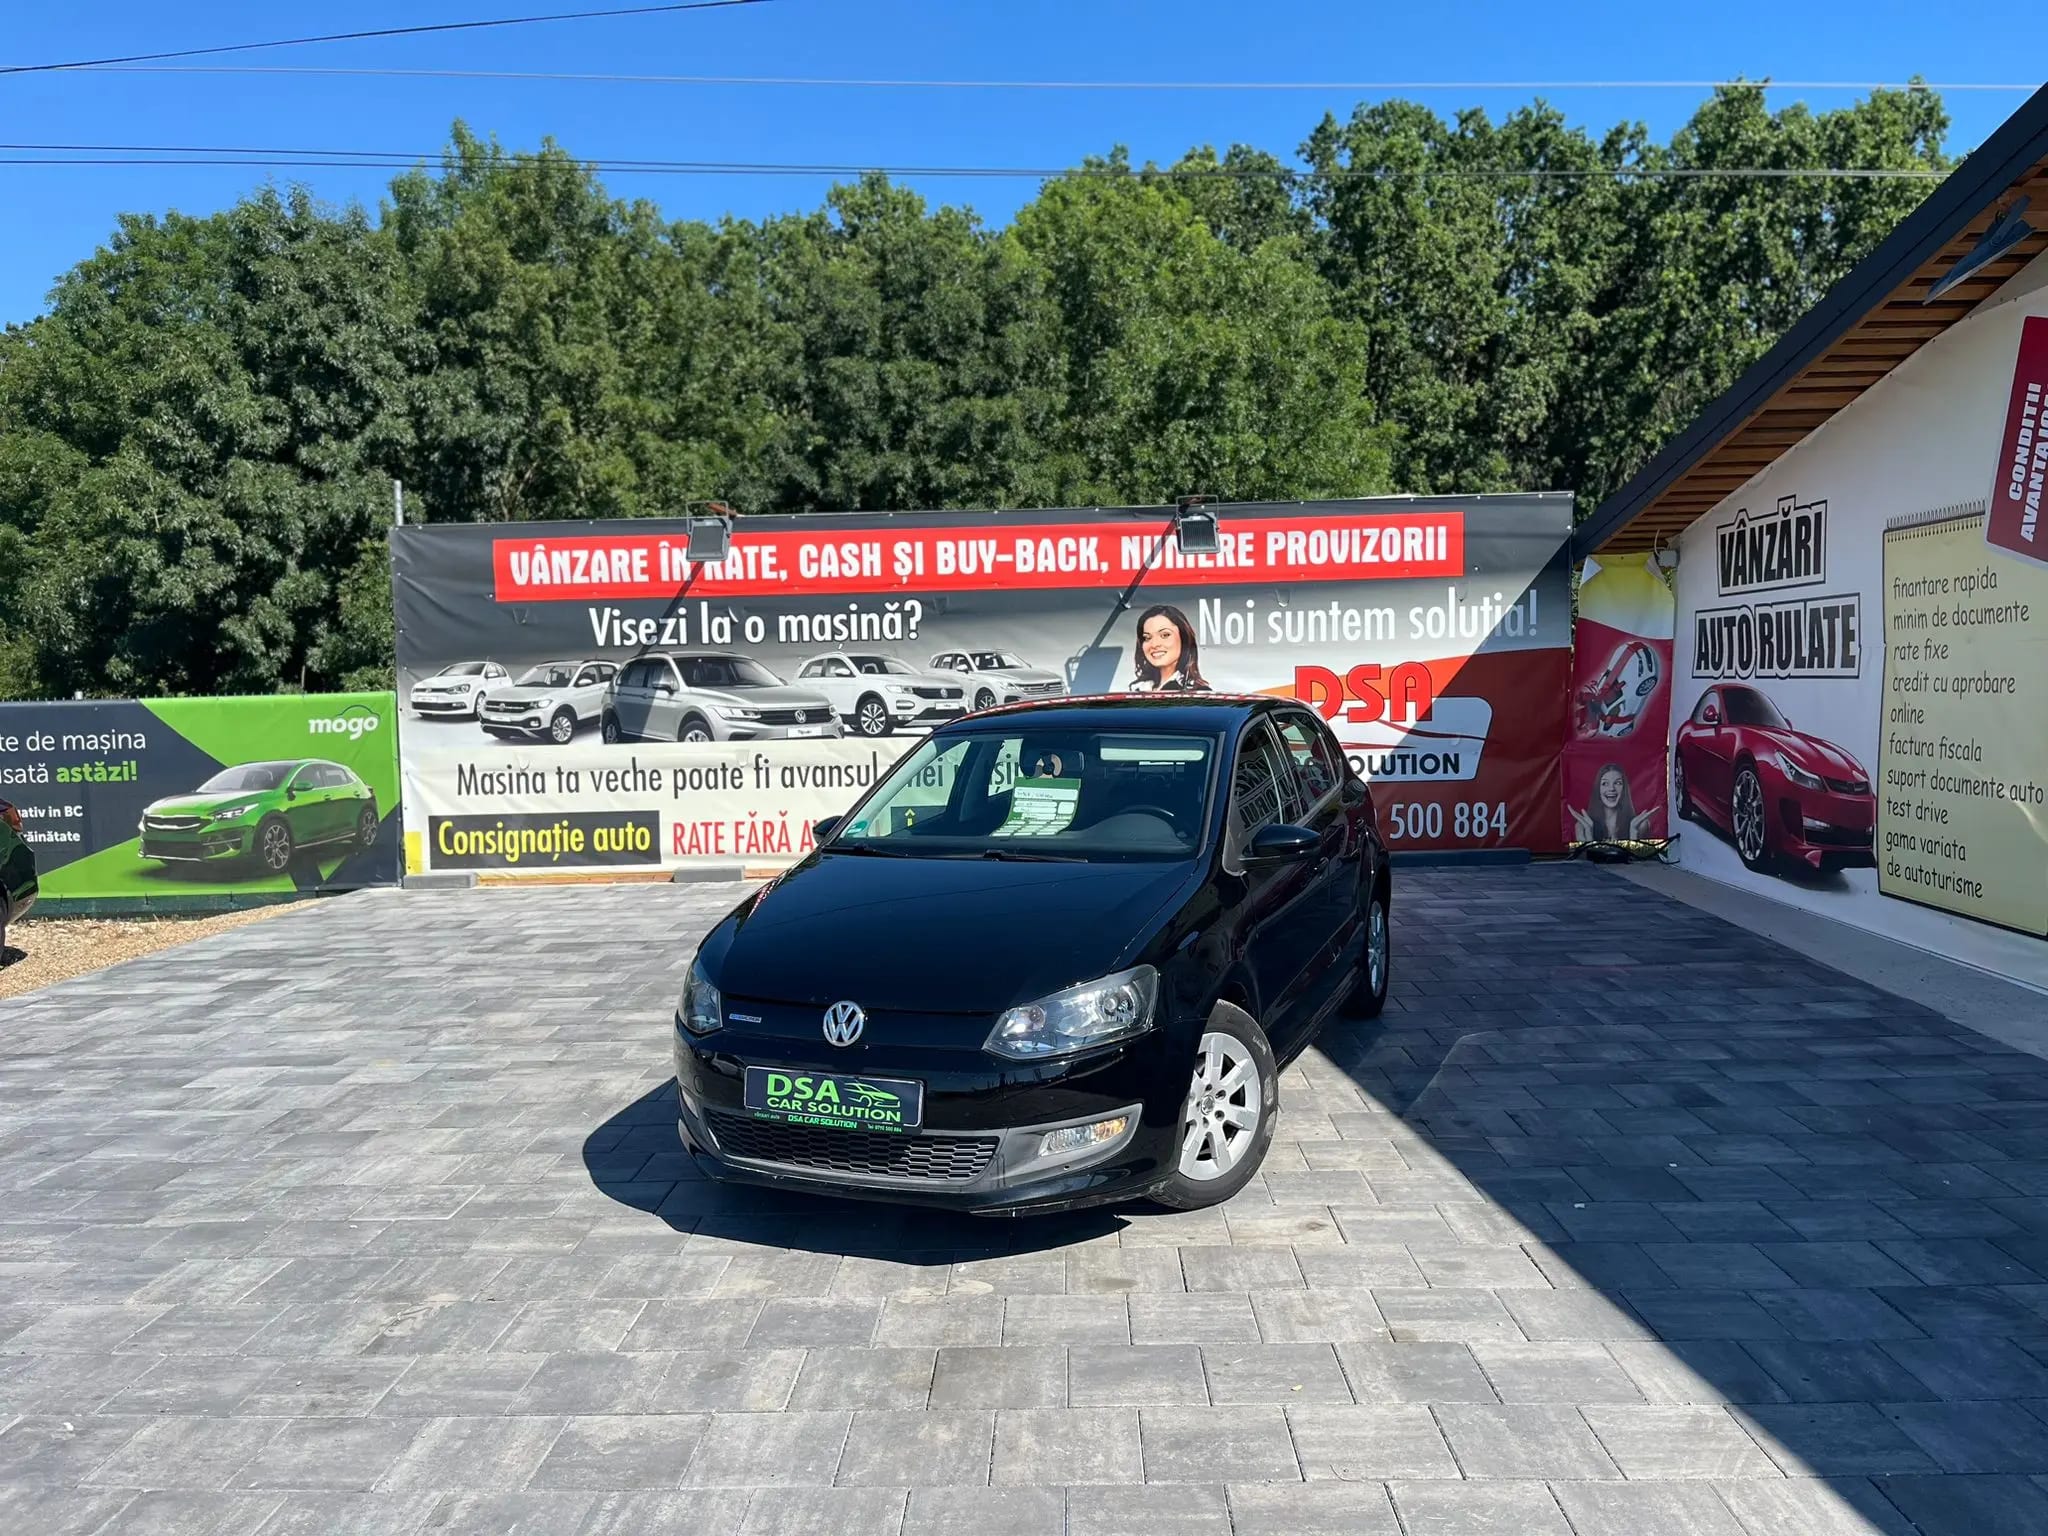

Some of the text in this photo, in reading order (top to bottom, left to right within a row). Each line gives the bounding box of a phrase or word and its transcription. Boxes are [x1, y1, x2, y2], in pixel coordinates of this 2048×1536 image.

[2009, 382, 2042, 501] CONDITII
[510, 543, 649, 586] VÂNZARE
[799, 542, 882, 580] CASH
[893, 541, 925, 584] ȘI
[1265, 526, 1447, 567] PROVIZORII
[1719, 505, 1823, 588] VÂNZĂRI
[1893, 565, 1998, 600] finantare rapida
[588, 606, 688, 647] Visezi
[700, 601, 731, 645] la
[744, 615, 766, 644] o
[1199, 598, 1255, 646] Noi
[1267, 600, 1396, 644] suntem
[1893, 600, 2030, 631] minim de documente
[1695, 603, 1856, 673] AUTO RULATE
[1893, 637, 1949, 662] rate fixe
[1294, 661, 1433, 724] DSA
[1892, 670, 2016, 700] credit cu aprobare
[309, 713, 379, 741] mogo
[1890, 701, 1925, 724] online
[26, 730, 55, 752] de
[62, 729, 146, 755] mașina
[1889, 732, 1982, 762] factura fiscala
[0, 760, 137, 784] sată astăzi!
[555, 766, 579, 794] ta
[590, 757, 662, 792] veche
[673, 762, 744, 799] poate
[753, 753, 770, 789] fi
[781, 751, 877, 788] avansul
[1348, 753, 1460, 776] OLUTION
[1887, 768, 2044, 804] suport documente auto
[48, 805, 61, 818] in
[64, 805, 83, 818] BC
[1390, 802, 1507, 839] 500 884
[1886, 796, 1949, 825] test drive
[438, 819, 651, 863] Consignație auto
[672, 821, 726, 855] RATE
[733, 809, 792, 855] FĂRĂ
[1886, 831, 1966, 861] gama variata
[1886, 855, 1983, 899] de autoturisme
[767, 1074, 840, 1103] DSA
[766, 1097, 901, 1122] CAR SOLUTION
[788, 1114, 857, 1129] DSA CAR SOLUTION
